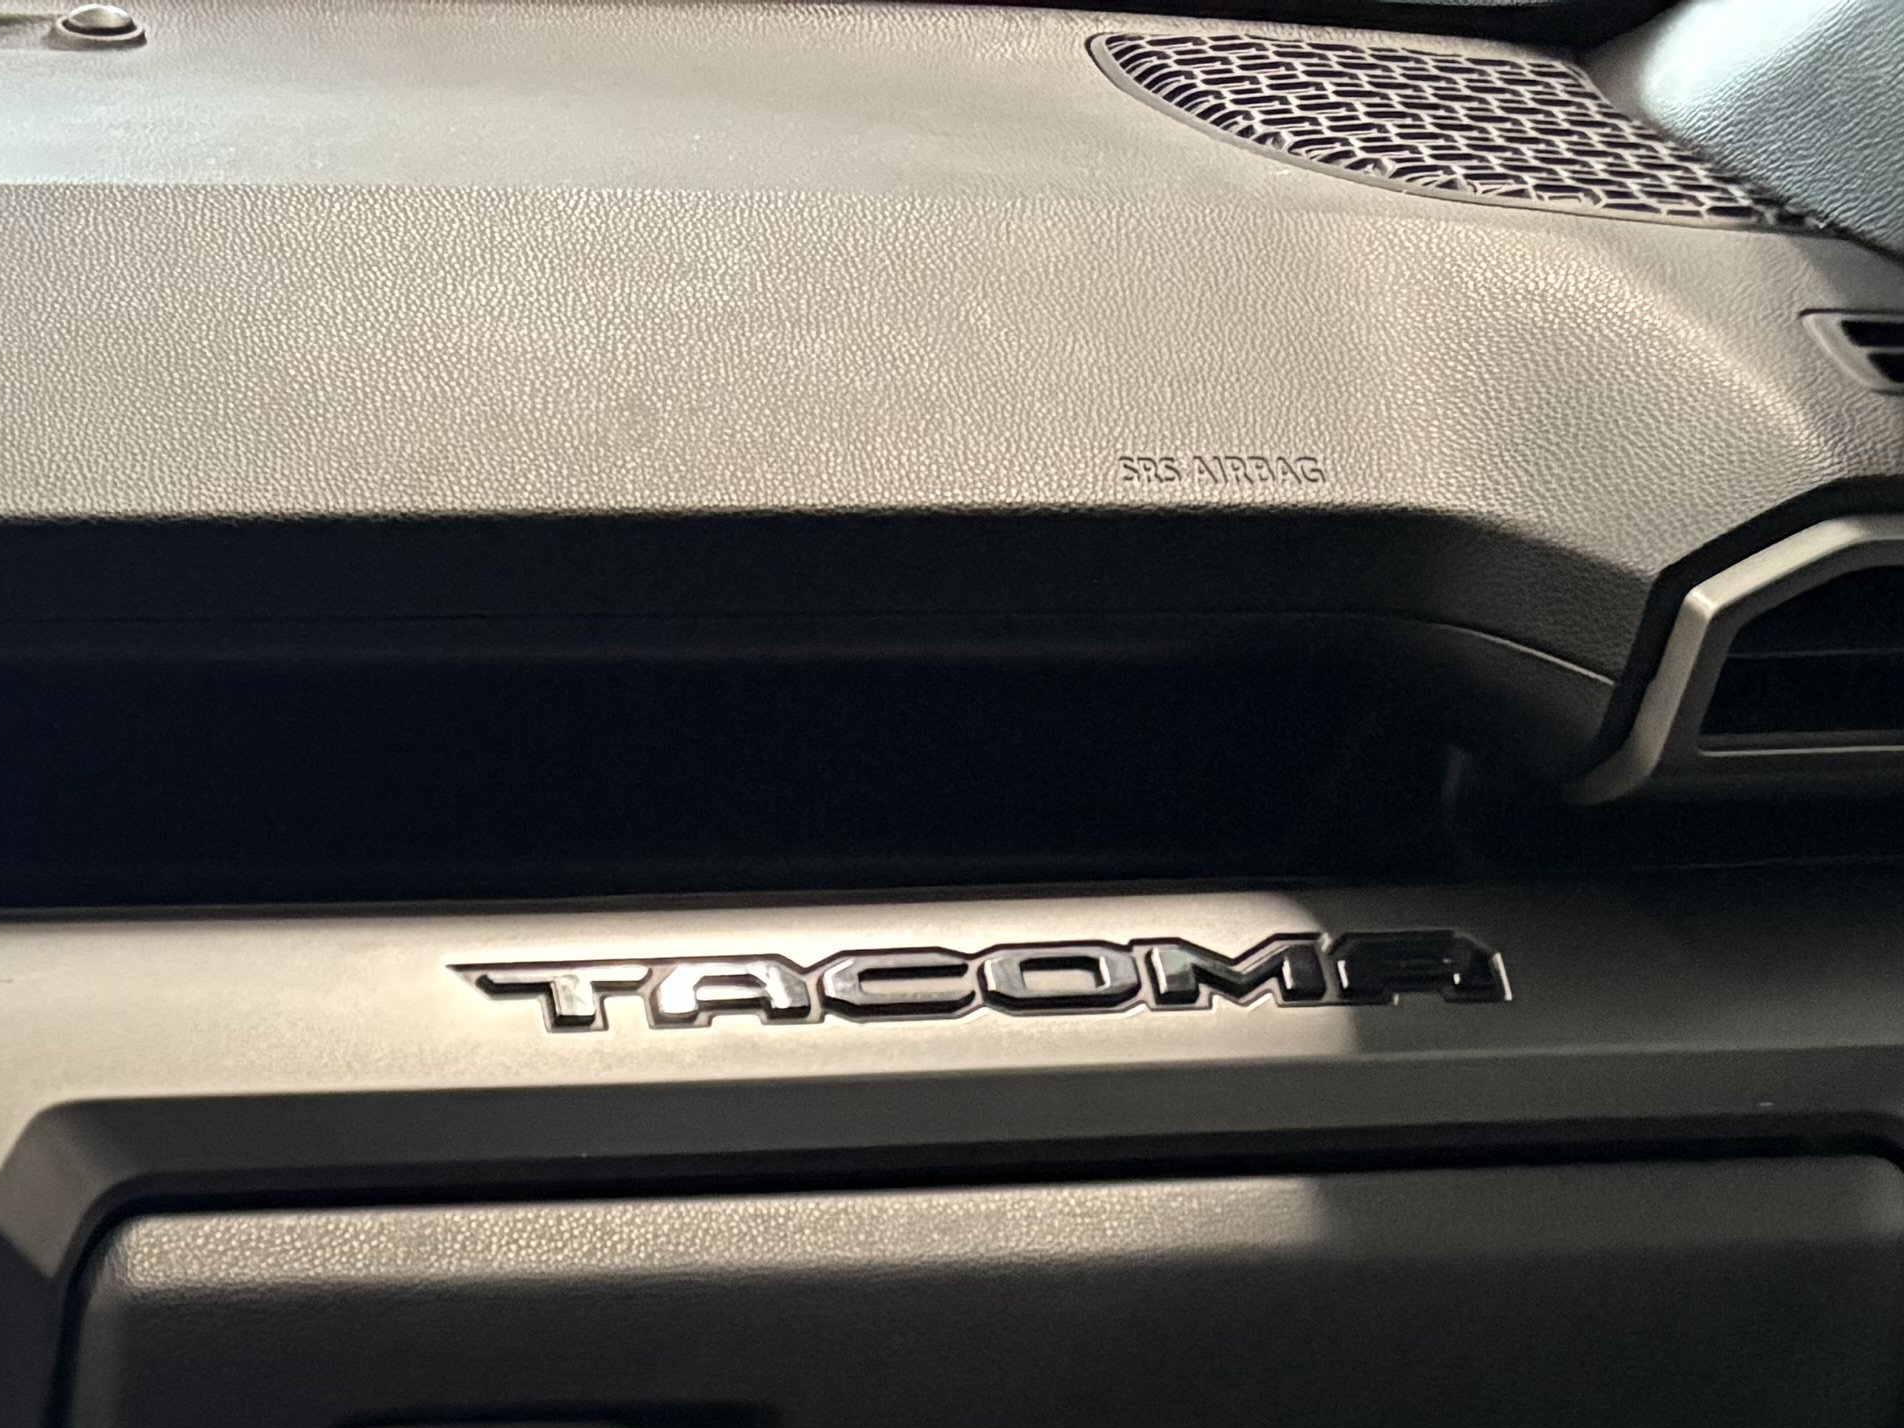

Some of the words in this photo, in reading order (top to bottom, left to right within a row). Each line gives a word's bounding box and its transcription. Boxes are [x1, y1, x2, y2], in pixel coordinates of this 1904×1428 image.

[1118, 455, 1182, 483] SRS
[1192, 455, 1327, 484] AIRBAG
[446, 928, 1513, 1033] TACOMA
